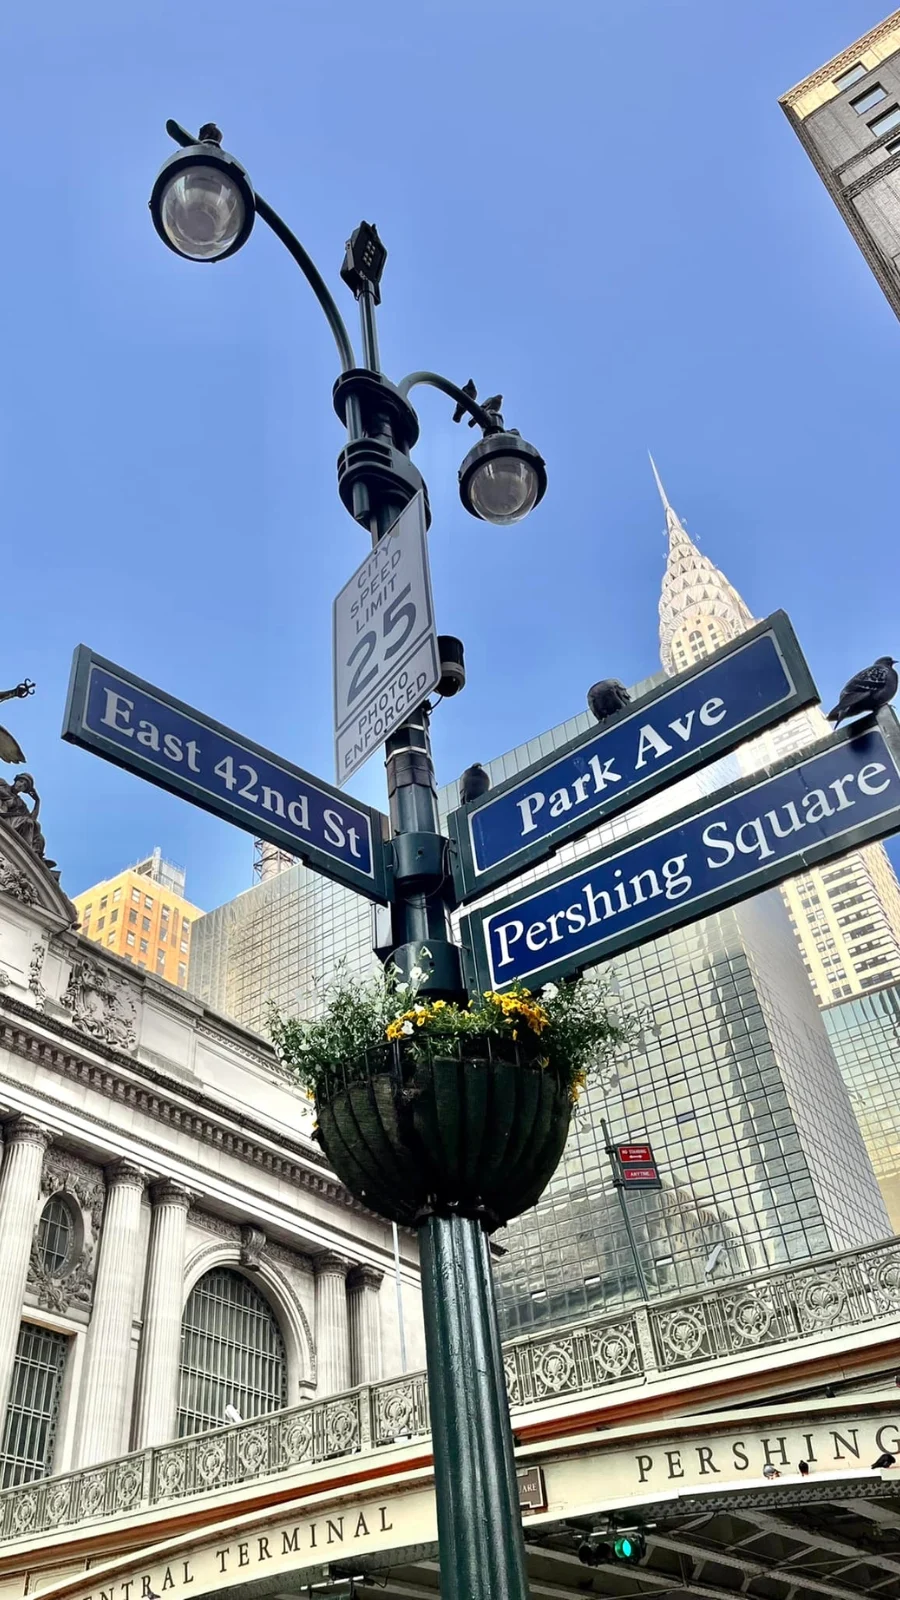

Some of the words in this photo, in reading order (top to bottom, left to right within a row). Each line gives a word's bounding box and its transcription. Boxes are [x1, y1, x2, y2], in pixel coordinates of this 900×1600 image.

[350, 549, 402, 619] SPEED
[356, 573, 397, 635] LIMIT
[357, 536, 392, 588] CITY
[346, 583, 417, 707] 25
[344, 671, 427, 770] ENFORCED
[358, 671, 409, 735] PHOTO
[100, 686, 201, 773] East
[214, 755, 312, 831] 42nd
[323, 808, 362, 859] St
[516, 754, 622, 837] Park
[634, 696, 727, 770] Ave
[494, 852, 693, 968] Pershing
[701, 760, 892, 869] Square
[636, 1424, 900, 1482] PERSHING
[83, 1561, 194, 1600] TRAL
[215, 1506, 394, 1573] TERMINAL
